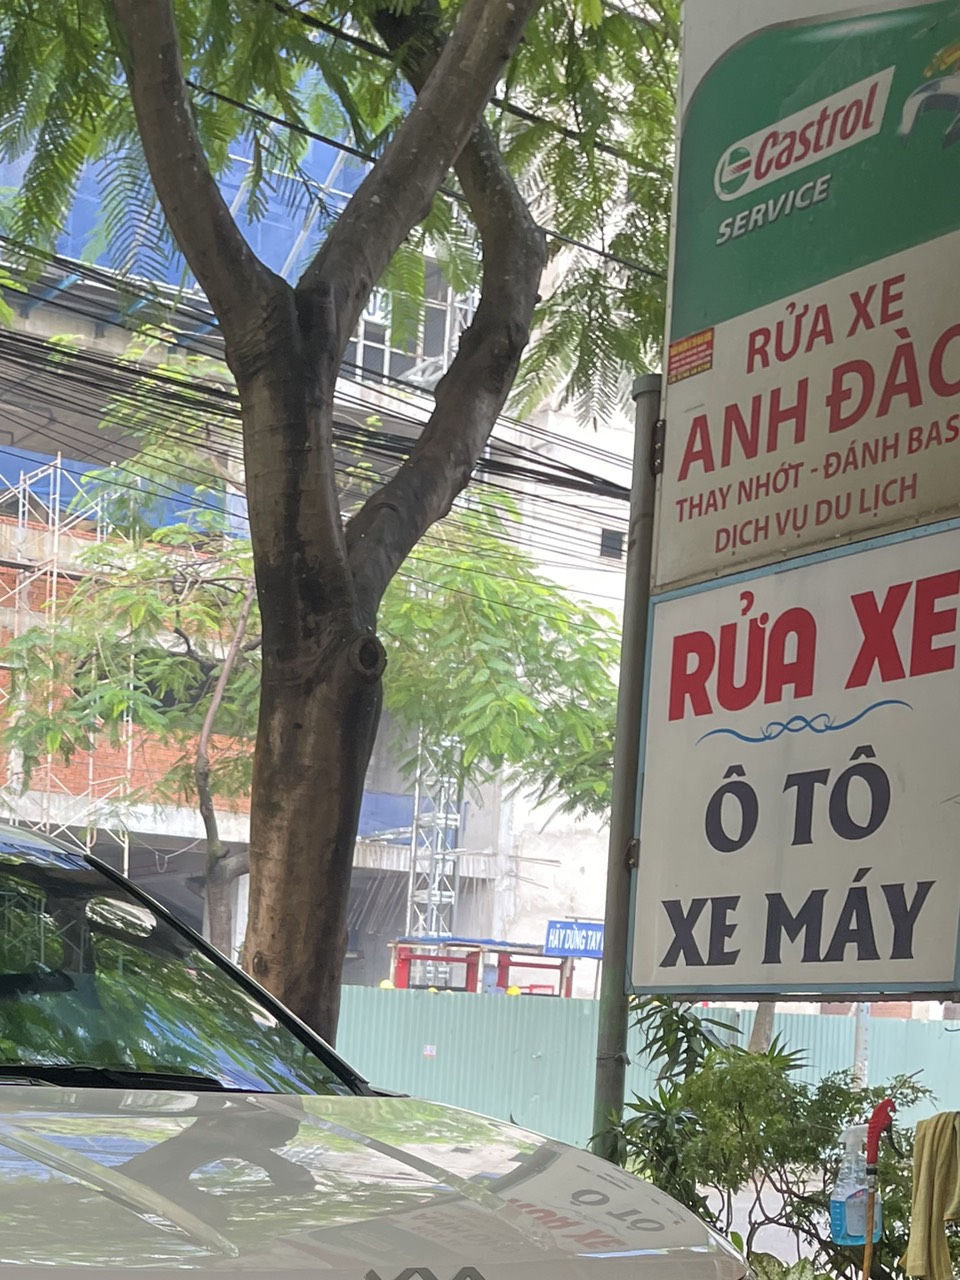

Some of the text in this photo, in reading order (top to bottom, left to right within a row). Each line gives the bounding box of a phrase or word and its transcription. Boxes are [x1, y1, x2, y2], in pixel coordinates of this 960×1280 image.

[754, 82, 878, 180] Castrol
[716, 173, 831, 245] SERVICE
[746, 301, 834, 374] RỬA
[846, 273, 905, 338] XE
[675, 484, 732, 522] THAY
[737, 461, 804, 505] NHỚT
[823, 433, 899, 479] ĐÁNH
[677, 376, 809, 482] ANH
[715, 473, 917, 556] DỊCH VỤ DU LỊCH
[668, 569, 960, 722] RỬA XE
[705, 745, 891, 853] Ô TÔ
[658, 866, 936, 968] XE MÁY
